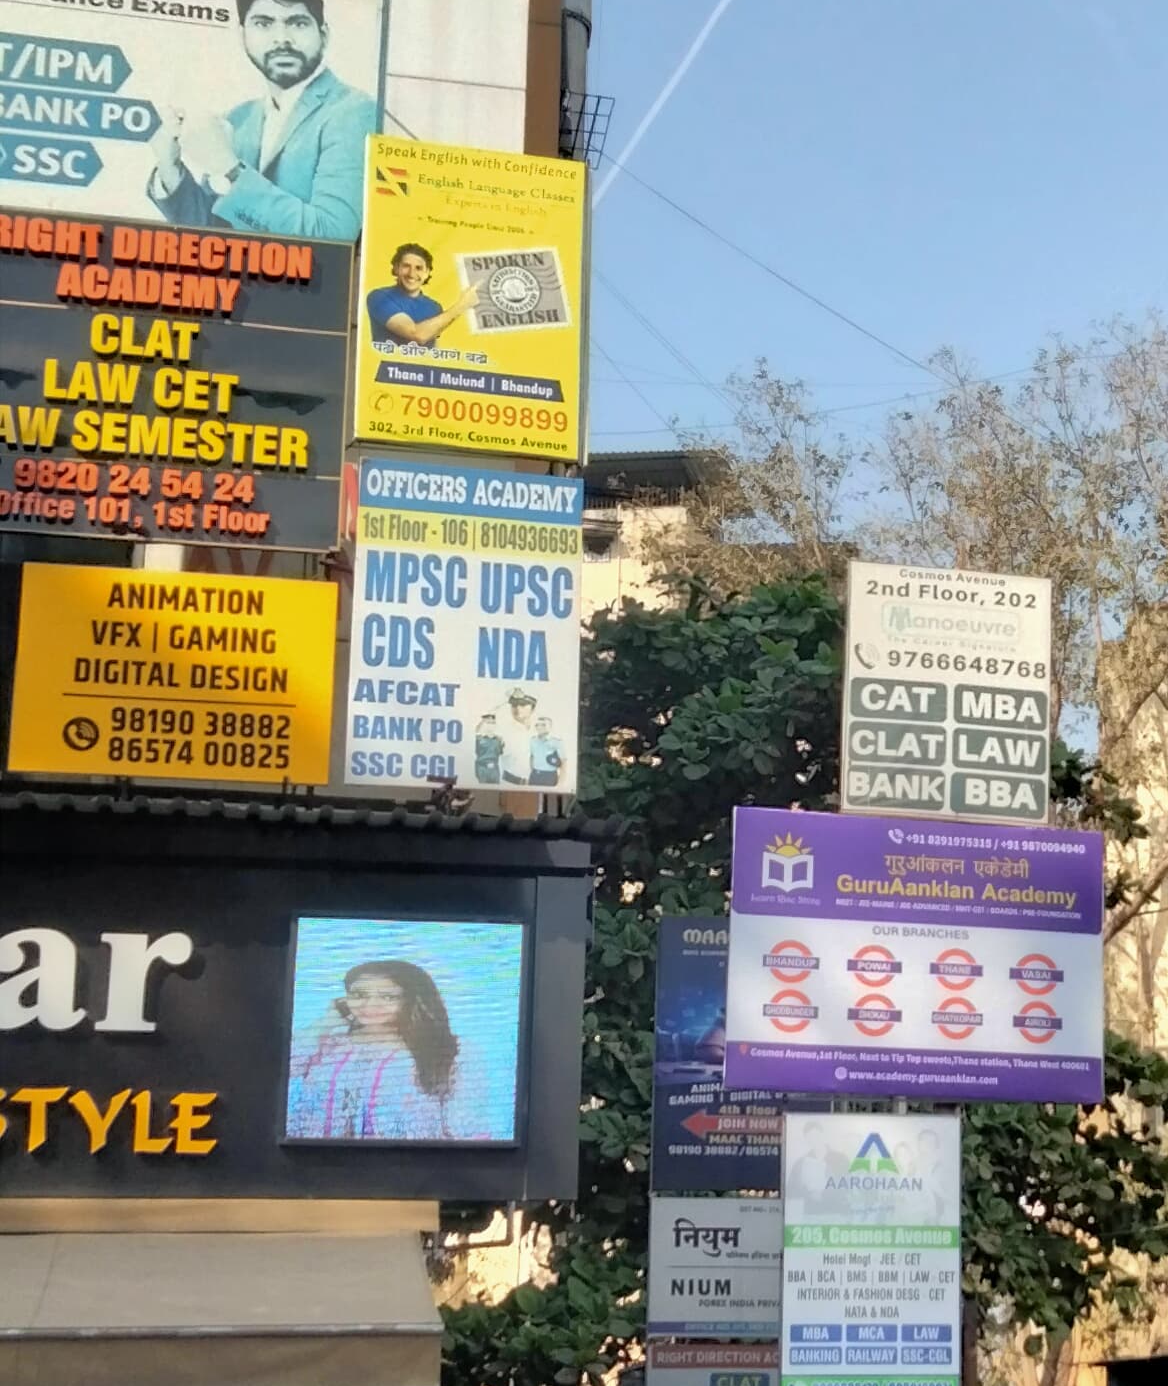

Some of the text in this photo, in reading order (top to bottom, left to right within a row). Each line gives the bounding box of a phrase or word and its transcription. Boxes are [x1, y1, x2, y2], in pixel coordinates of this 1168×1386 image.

[101, 102, 152, 133] PO
[12, 144, 87, 180] SSC
[377, 142, 577, 180] Speak English with Confidence
[417, 173, 576, 204] English Language Classes
[112, 225, 313, 281] DIRECTION
[471, 251, 546, 271] SPOKEN
[56, 262, 241, 313] ACADEMY
[481, 308, 561, 329] ENGLISH
[90, 313, 201, 361] CLAT
[43, 358, 240, 414] LAW CET
[387, 366, 553, 398] Thane Mulund Bhandup
[400, 394, 568, 433] 7900099899
[70, 410, 310, 469] SEMESTER
[368, 421, 568, 452] 302, 3rd Floor, Cosmos Avenue
[14, 458, 255, 505] 9820 24 54 24
[366, 468, 578, 514] OFFICERS ACADEMY
[153, 500, 271, 535] 1st Floor
[362, 512, 429, 542] 1st Floor
[364, 549, 574, 620] MPSC UPSC
[899, 568, 1007, 587] Cosmos Avenue
[107, 582, 265, 616] ANIMATION
[866, 580, 1037, 609] 2nd Floor, 202
[91, 619, 277, 655] VFX GAMING
[361, 612, 550, 682] CDS NDA
[73, 657, 288, 694] DIGITAL DESIGN
[887, 649, 1047, 679] 9766648768
[353, 678, 461, 708] AFCAT
[860, 683, 1042, 724] CAT MBA
[110, 706, 291, 740] 98190 38882
[352, 714, 463, 744] BANK PO
[107, 736, 290, 770] 86574 00825
[351, 751, 403, 778] SSC
[851, 729, 1041, 767] CLAT LAW
[848, 770, 1038, 811] BANK BBA
[836, 874, 975, 900] GuruAanklan
[982, 883, 1076, 909] Academy
[872, 925, 970, 940] OUR BRANCHES
[717, 1116, 779, 1130] JOIN NOW
[825, 1176, 923, 1192] AAROHAAN
[672, 1218, 742, 1257] नियुम
[829, 1228, 952, 1245] Cosmos Avenue
[670, 1278, 732, 1296] NIUM
[787, 1271, 955, 1284] BBA BCA LAW CET
[797, 1288, 946, 1301] INTERIOR FASHION CET
[803, 1327, 940, 1340] MBA MCA LAW
[657, 1351, 693, 1363] RIGHT
[696, 1351, 761, 1363] DIRECTION
[791, 1349, 840, 1362] BANKING
[848, 1348, 895, 1363] RAILWAY
